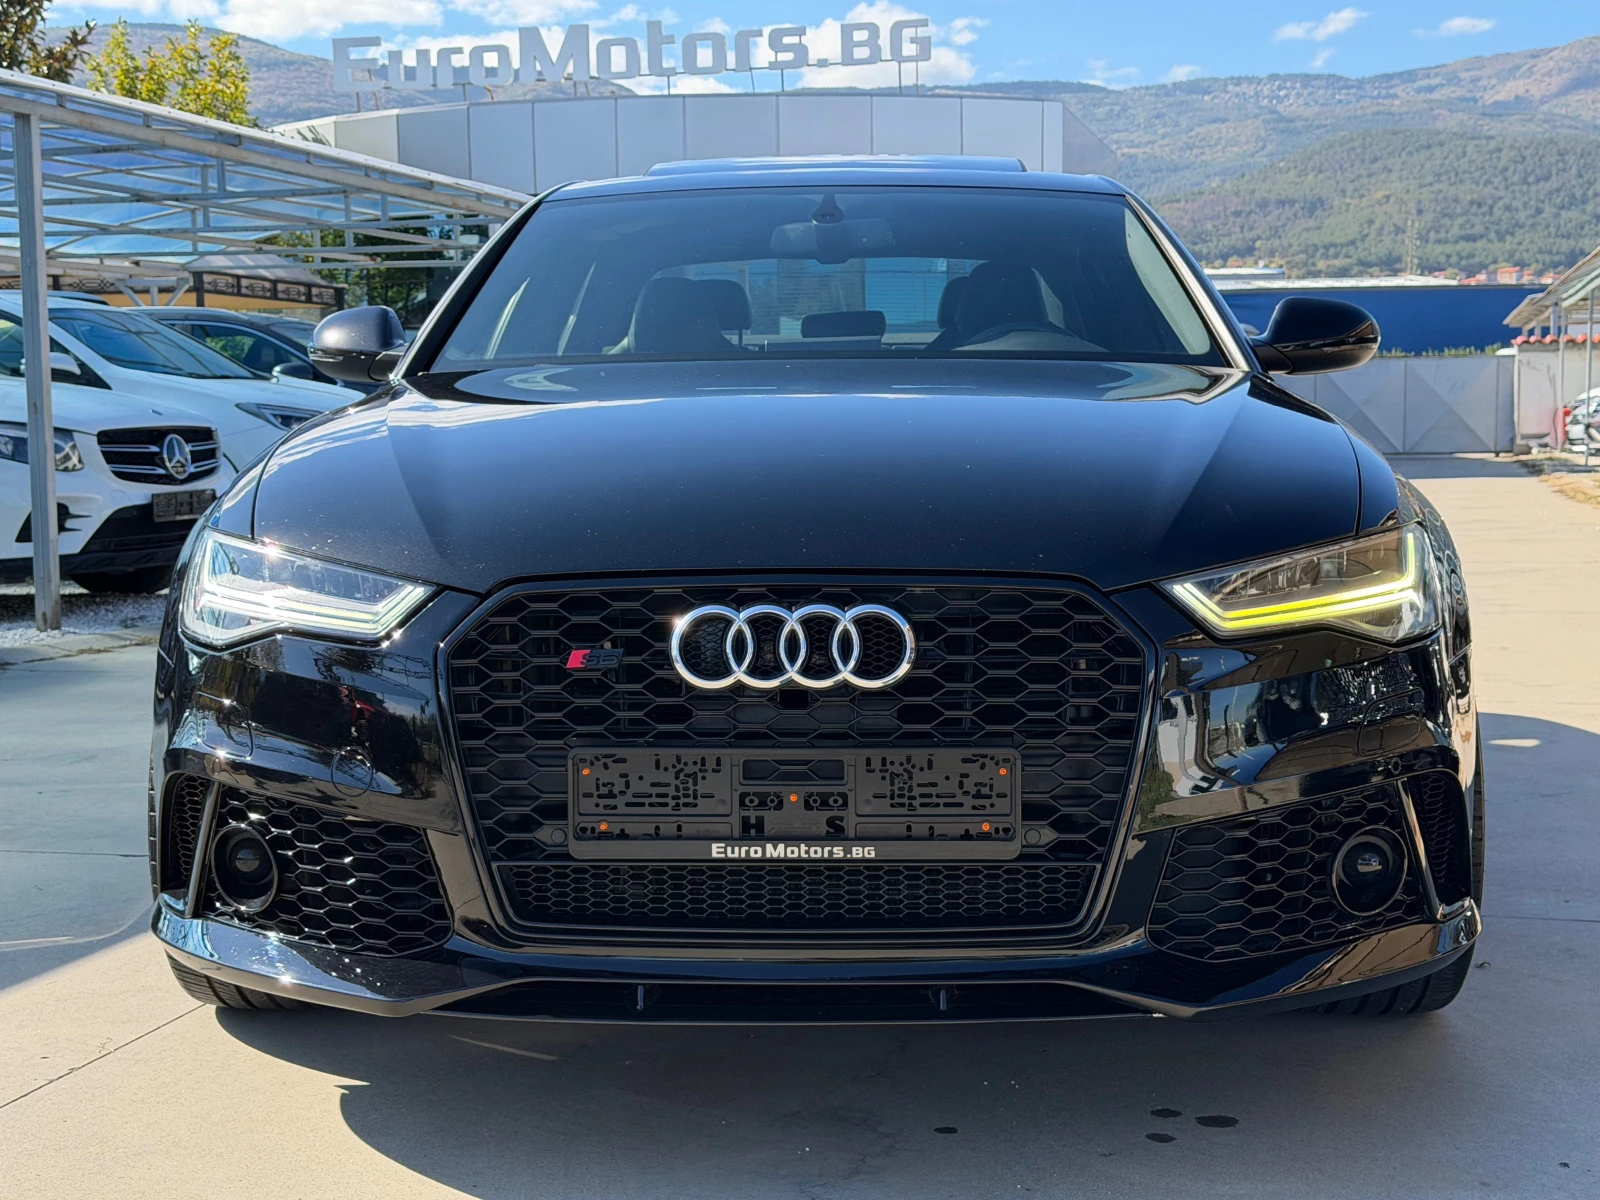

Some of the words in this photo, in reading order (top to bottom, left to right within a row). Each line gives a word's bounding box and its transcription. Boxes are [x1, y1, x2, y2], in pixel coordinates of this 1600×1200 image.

[332, 18, 932, 92] EuroMotors.BG
[741, 815, 765, 838] H
[825, 815, 846, 838] S
[711, 843, 876, 858] EuroMotors.BG
